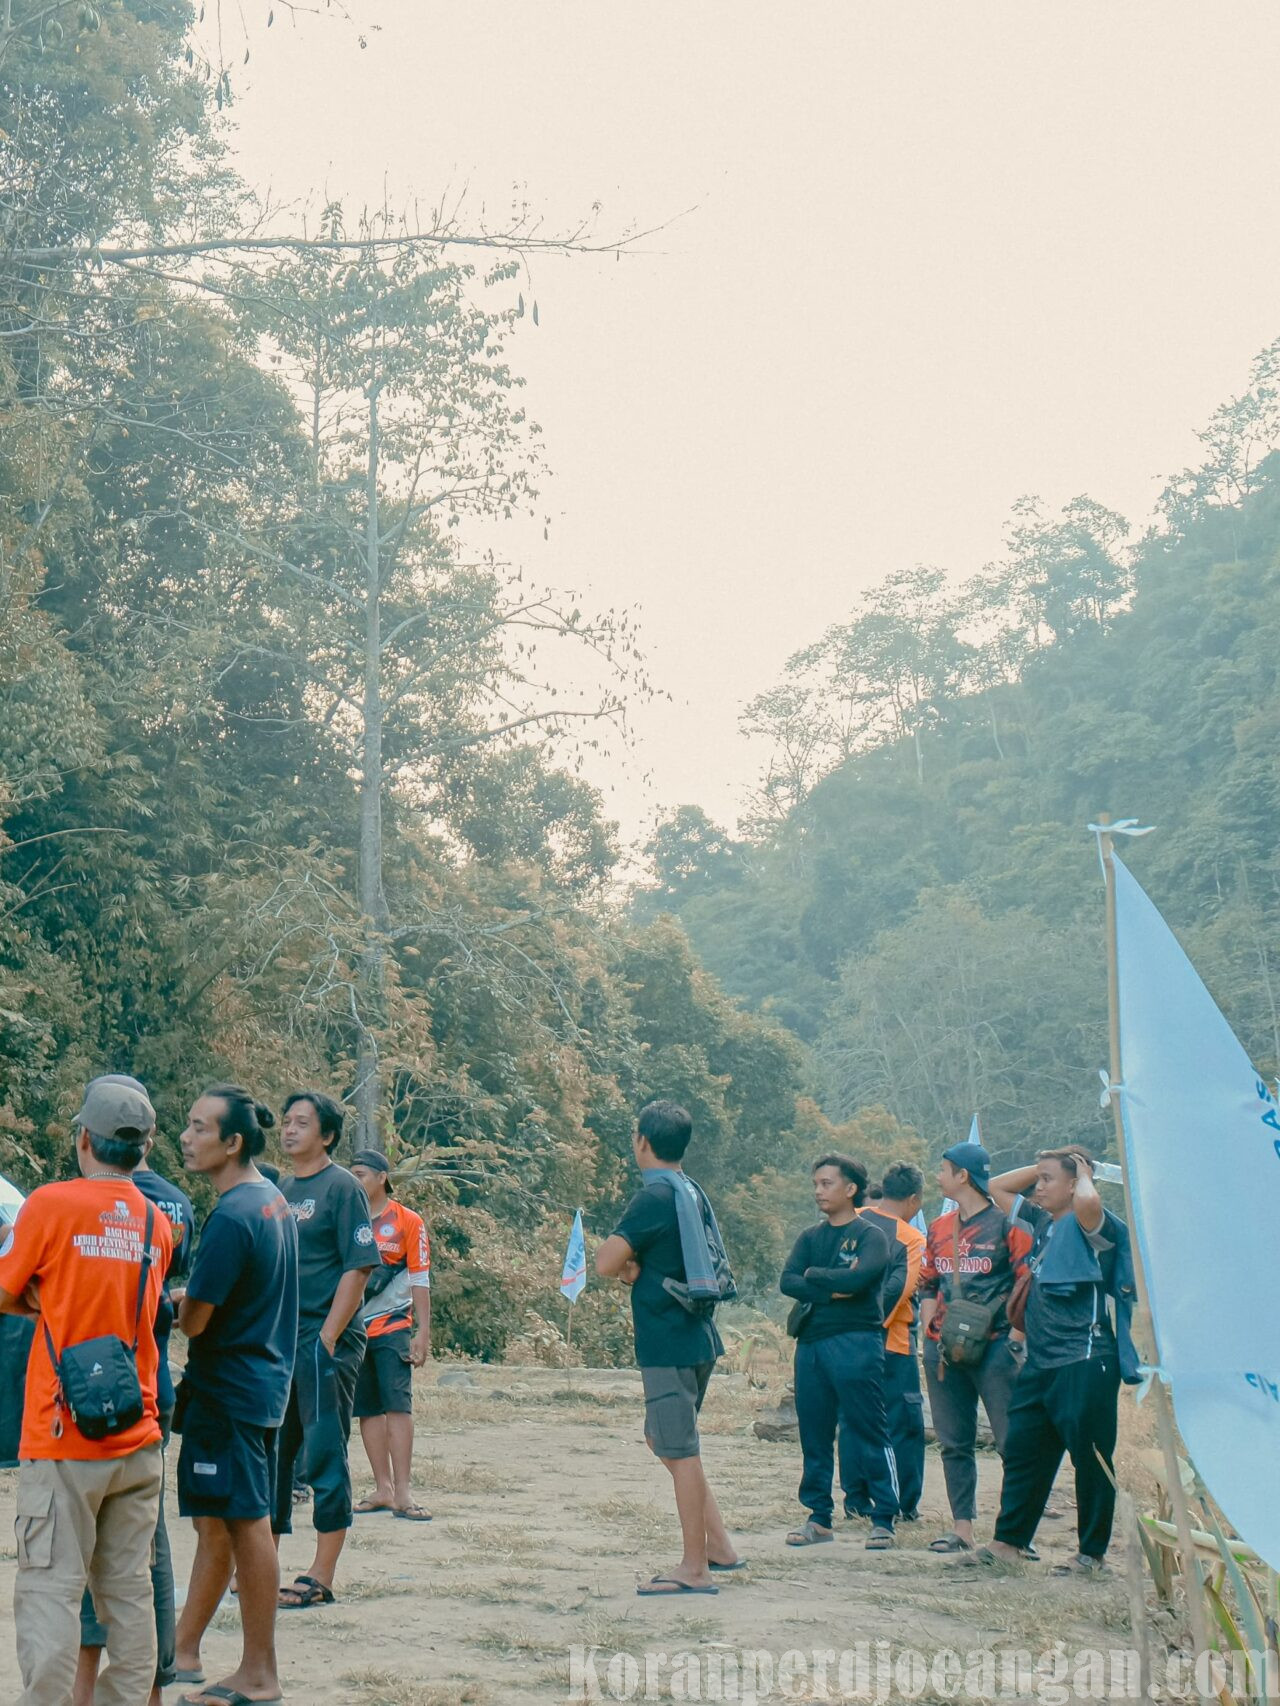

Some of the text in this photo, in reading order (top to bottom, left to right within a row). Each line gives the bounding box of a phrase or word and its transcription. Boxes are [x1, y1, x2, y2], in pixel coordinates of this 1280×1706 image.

[73, 1235, 98, 1246] LEBIH
[99, 1236, 129, 1250] PENTING
[80, 1245, 100, 1257] DARI
